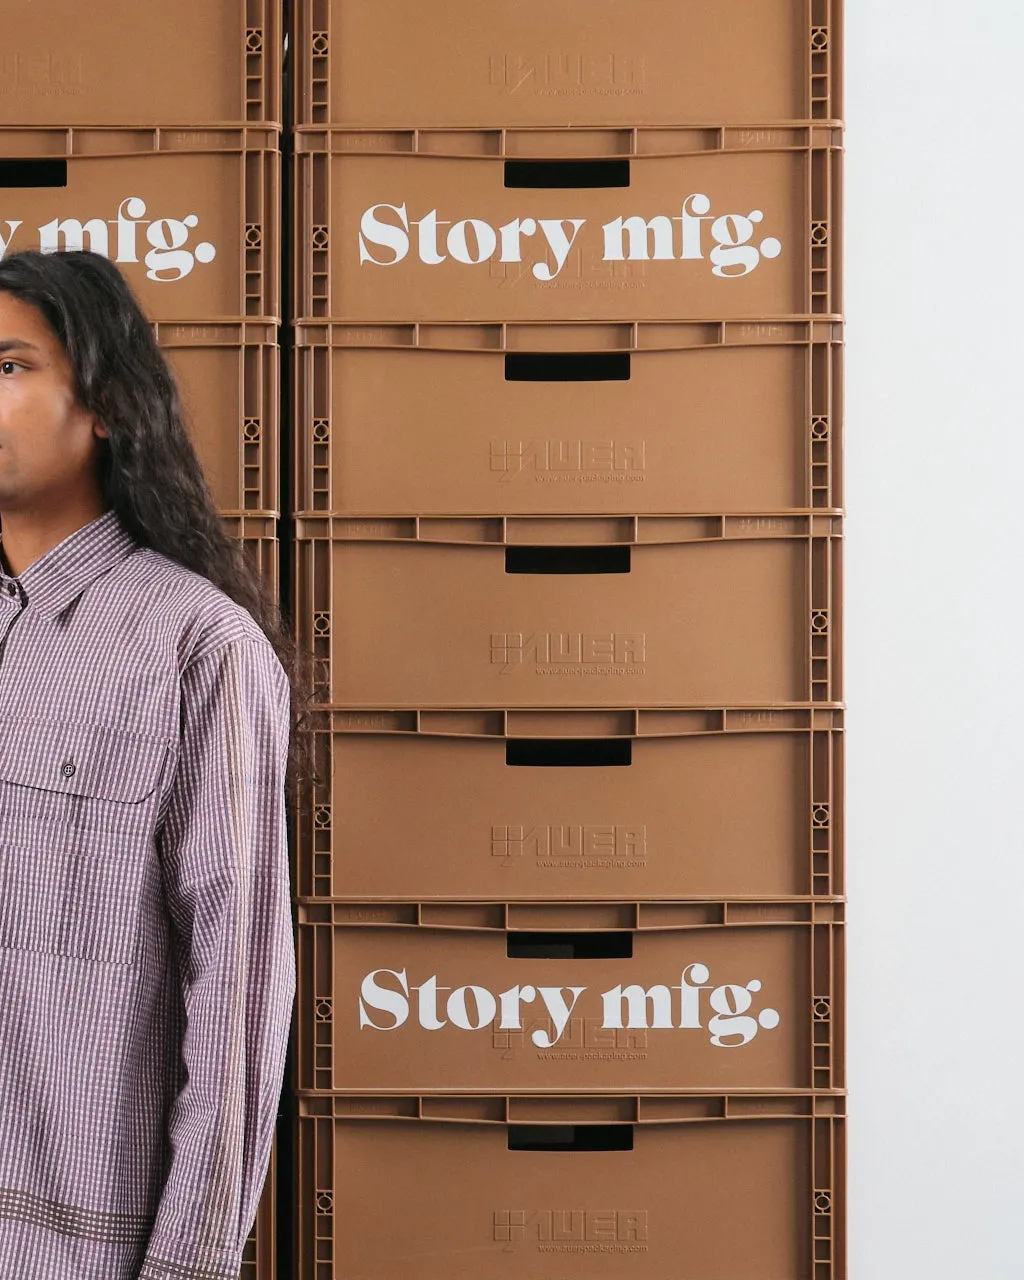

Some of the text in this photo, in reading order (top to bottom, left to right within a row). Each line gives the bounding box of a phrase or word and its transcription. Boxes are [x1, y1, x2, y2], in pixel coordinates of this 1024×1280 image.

[359, 202, 586, 281] Story
[602, 193, 781, 278] mfg.
[359, 968, 586, 1048] Story
[601, 963, 779, 1047] mfg.
